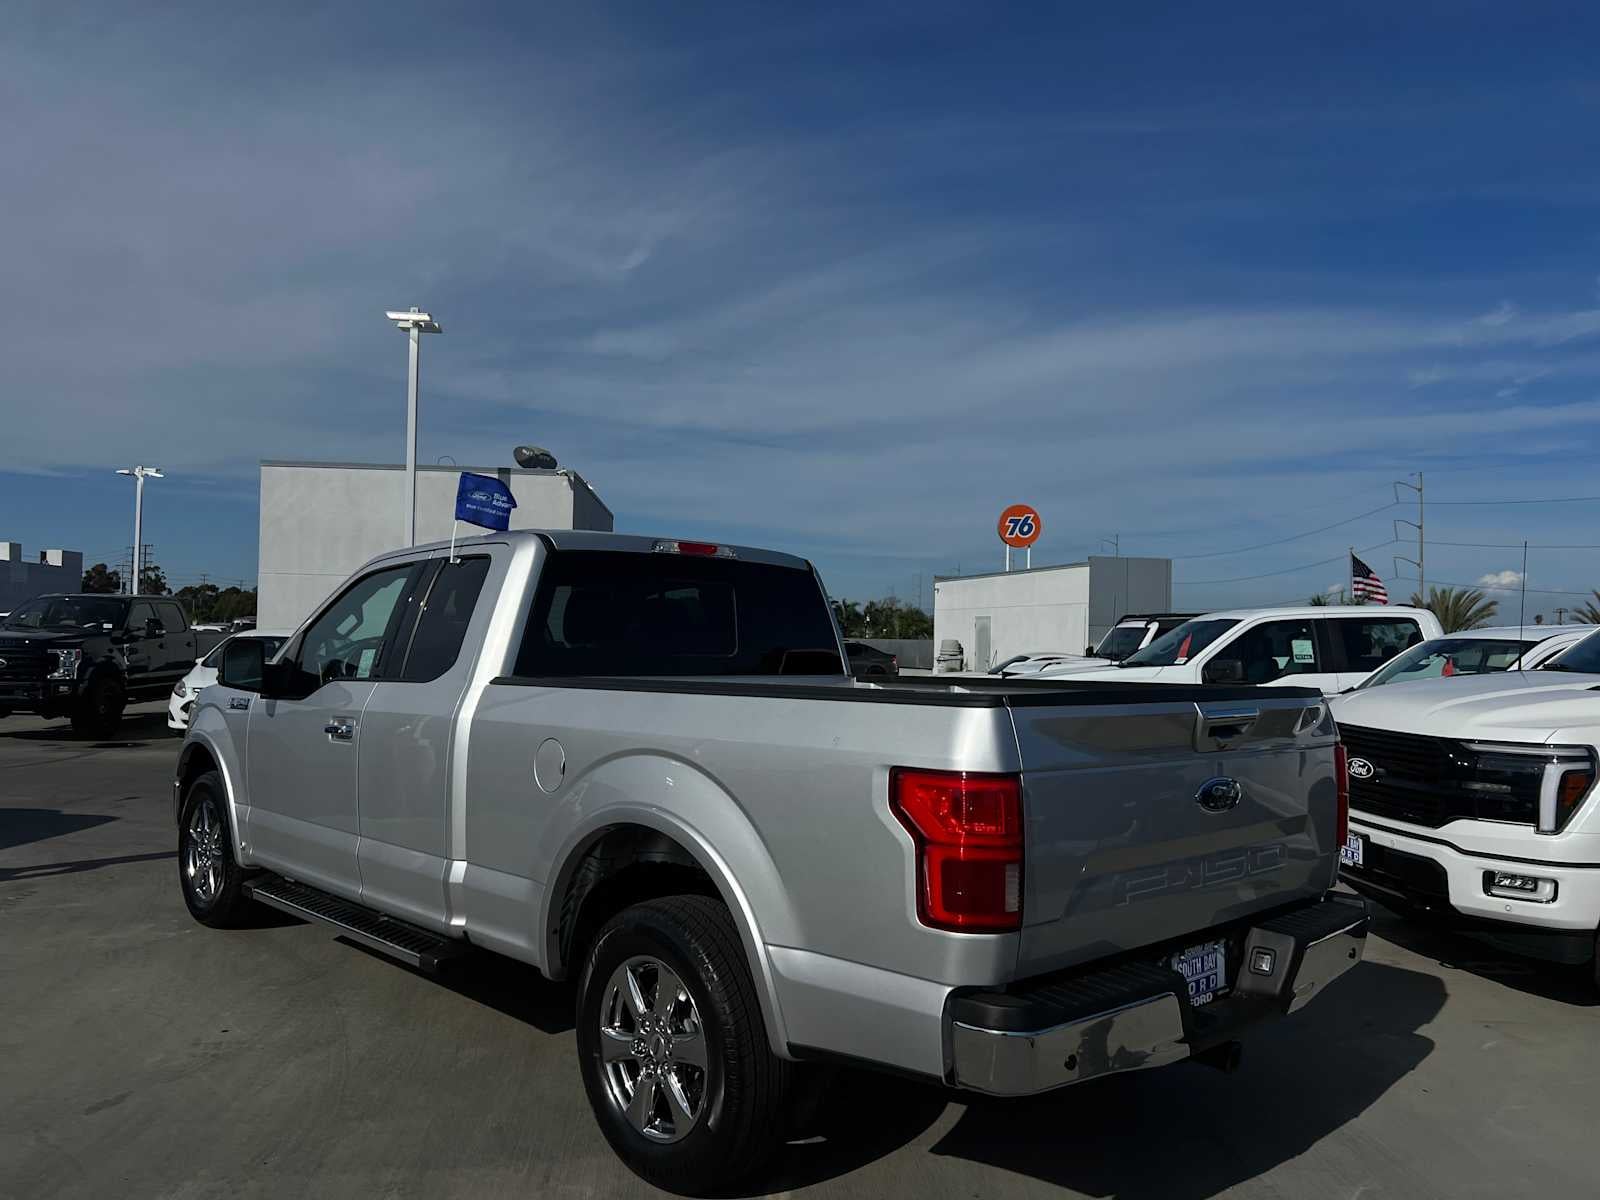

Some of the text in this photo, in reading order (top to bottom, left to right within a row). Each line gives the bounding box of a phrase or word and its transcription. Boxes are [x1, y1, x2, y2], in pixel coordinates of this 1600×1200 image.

[493, 492, 508, 502] Blue
[1005, 513, 1036, 538] 76
[1350, 760, 1368, 776] Ford
[1341, 848, 1359, 861] ORD
[1177, 952, 1217, 978] SOUTH BAY
[1188, 974, 1217, 996] ORD
